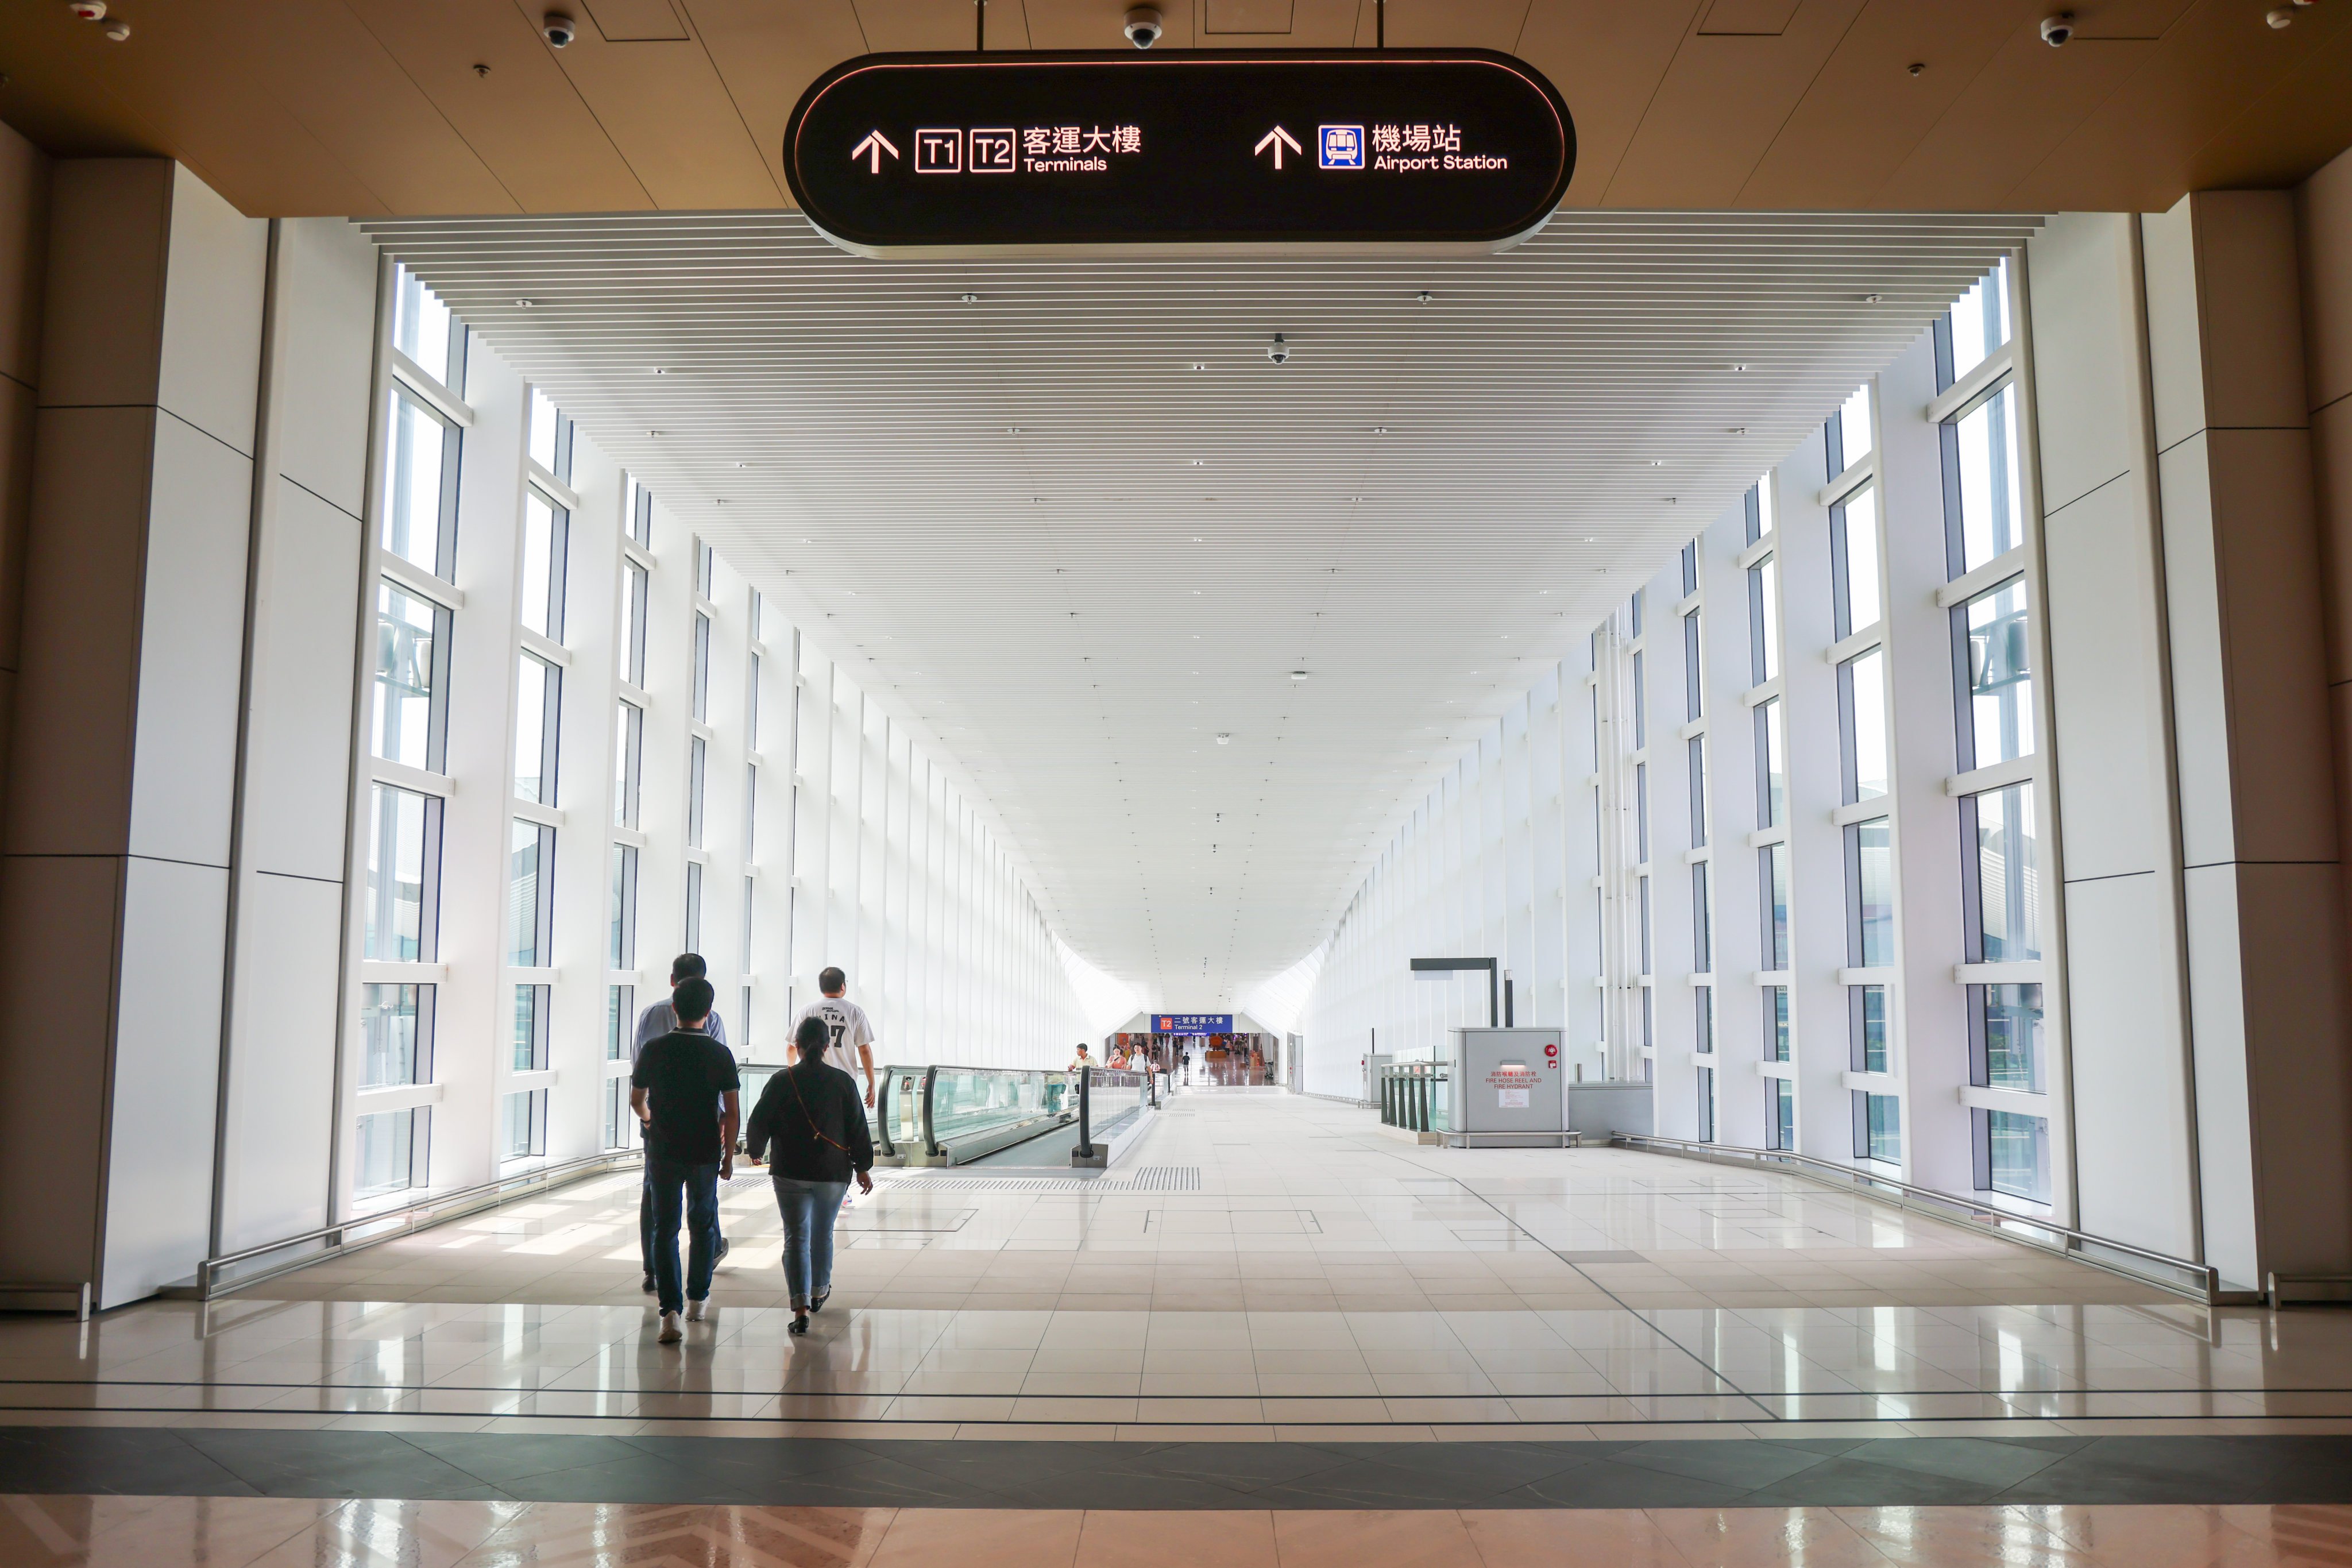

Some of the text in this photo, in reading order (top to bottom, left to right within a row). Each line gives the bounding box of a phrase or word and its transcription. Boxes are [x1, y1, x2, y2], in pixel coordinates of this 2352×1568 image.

[924, 138, 1010, 164] T1 T2
[1022, 125, 1141, 155] 客運大樓
[1372, 124, 1461, 152] 機場站
[1023, 156, 1107, 172] Terminals
[1374, 155, 1508, 173] Airport Station
